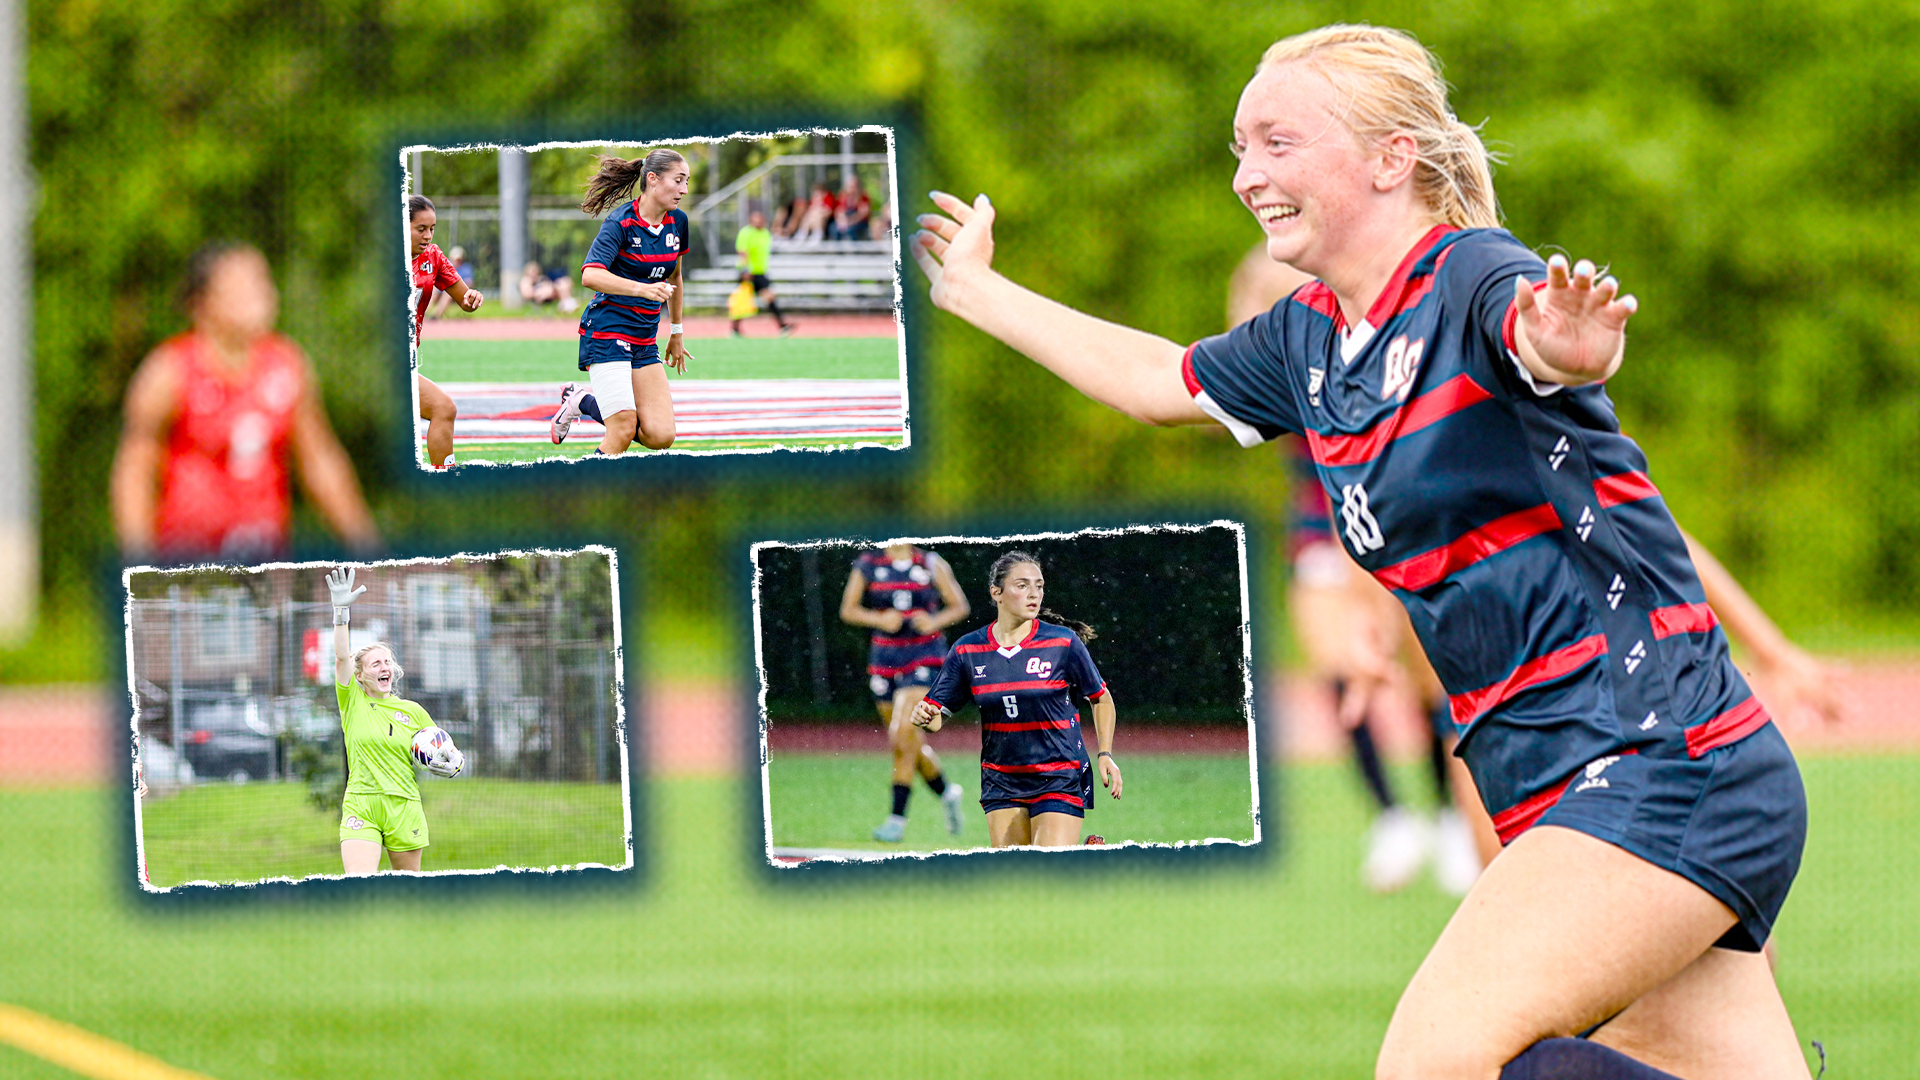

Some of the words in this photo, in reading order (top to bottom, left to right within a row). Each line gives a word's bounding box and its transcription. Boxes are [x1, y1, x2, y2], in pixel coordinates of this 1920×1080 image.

[1381, 333, 1427, 403] QC
[1341, 483, 1386, 556] 10
[1026, 656, 1052, 679] QC
[1002, 695, 1019, 718] 5
